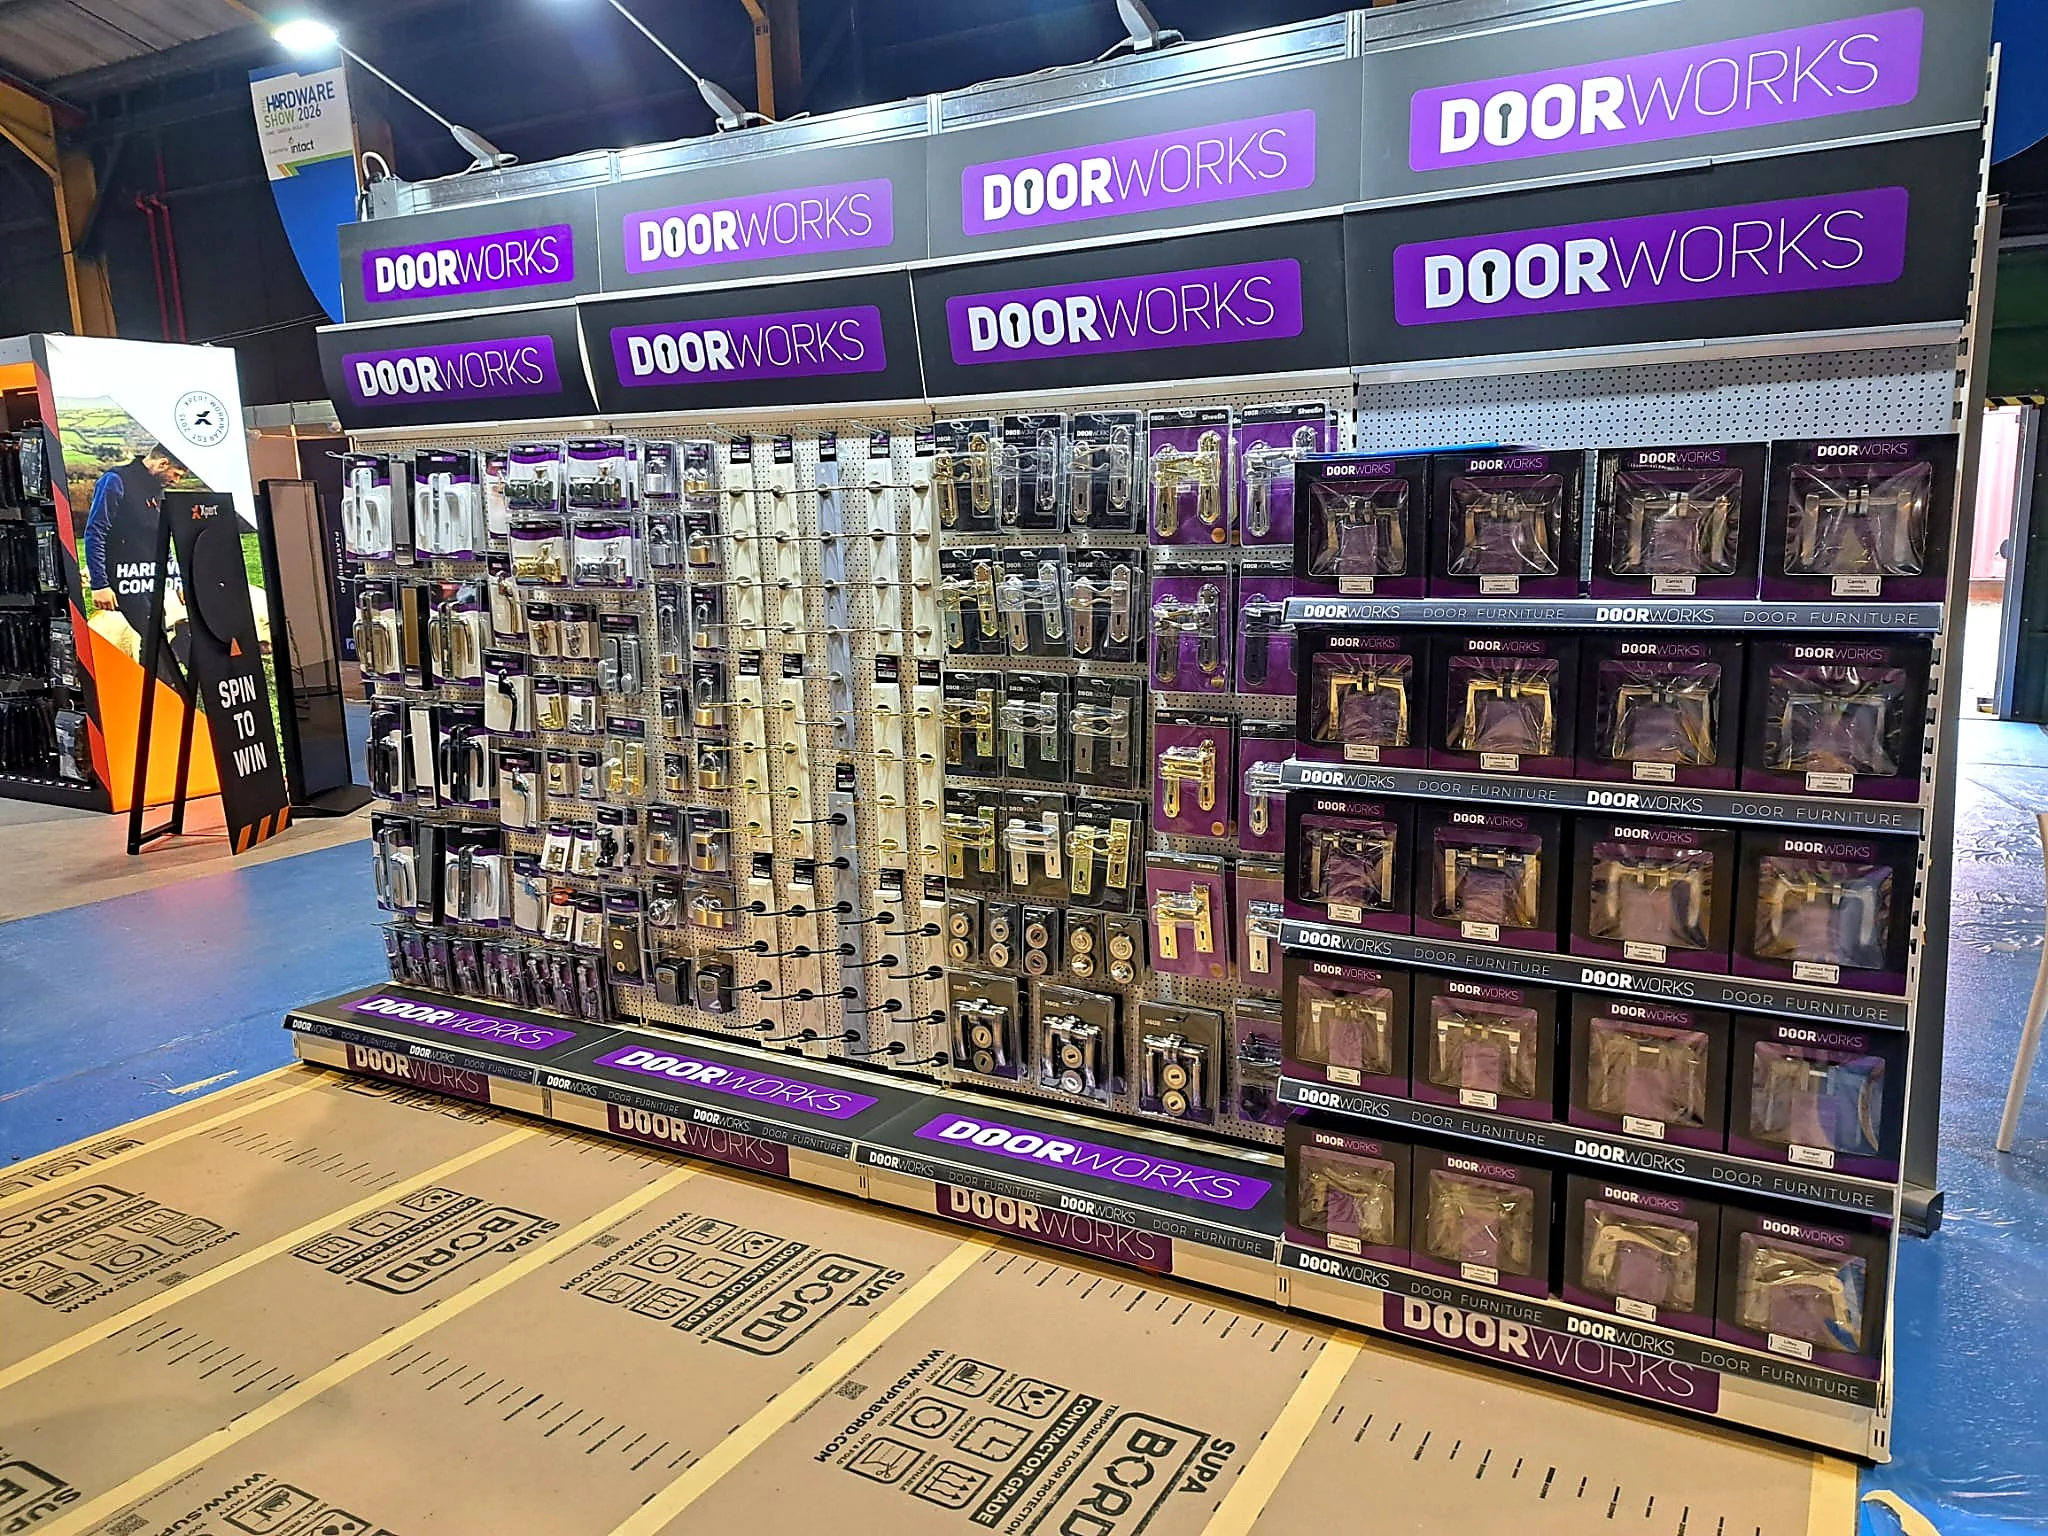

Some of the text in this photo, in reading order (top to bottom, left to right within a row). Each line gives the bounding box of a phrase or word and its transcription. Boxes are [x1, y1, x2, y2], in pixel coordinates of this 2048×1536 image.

[264, 104, 321, 128] SHOW 2026
[266, 81, 335, 113] HARDWARE
[1440, 34, 1879, 153] DOORWORKS
[983, 128, 1287, 221] DOORWORKS
[639, 193, 872, 262] DOORWORKS
[375, 236, 559, 293] DOORWORKS
[1425, 210, 1864, 309] DOORWORKS
[968, 276, 1275, 352] DOORWORKS
[628, 319, 864, 376] DOORWORKS
[355, 347, 543, 397] DOORWORKS
[1326, 463, 1391, 476] DOORWORKS
[1470, 457, 1543, 471] DOORWORKS
[1639, 450, 1720, 464] DOORWORKS
[1817, 443, 1908, 457] DOORWORKS
[1304, 605, 1919, 625] DOORWORKS DOOR FURNITURE DOORWORKS DOOR FURNITURE
[1330, 637, 1395, 649] DOORWORKS
[1468, 639, 1540, 652] DOORWORKS
[1621, 643, 1700, 657] DOORWORKS
[1795, 646, 1882, 660] DOORWORKS
[218, 675, 256, 708] SPIN
[233, 710, 255, 740] TO
[233, 742, 267, 777] WIN
[1300, 769, 1903, 826] DOORWORKS DOOR FURNITURE DOORWORKS DOOR FURNITURE
[1317, 800, 1380, 815] DOORWORKS
[1453, 813, 1523, 828] DOORWORKS
[1614, 826, 1692, 843] DOORWORKS
[1784, 840, 1870, 857] DOORWORKS
[1299, 930, 1889, 1021] DOORWORKS DOOR FURNITURE DOORWORKS DOOR FURNITURE
[1313, 963, 1376, 979] DOORWORKS
[1449, 982, 1519, 1001] DOORWORKS
[358, 998, 553, 1045] DOORWORKS
[1611, 1004, 1688, 1023] DOORWORKS
[1778, 1027, 1863, 1047] DOORWORKS
[293, 1020, 334, 1036] DOORWORKS
[409, 1045, 455, 1063] DOORWORKS
[355, 1046, 479, 1094] DOORWORKS
[614, 1046, 851, 1112] DOORWORKS
[547, 1075, 842, 1153] DOORWORKS DOOR FURNITURE DOORWORKS DOOR FURNITURE
[619, 1106, 776, 1165] DOORWORKS
[938, 1119, 1241, 1200] DOORWORKS
[1299, 1088, 1874, 1207] DOORWORKS DOOR FURNITURE DOORWORKS DOOR FURNITURE
[1315, 1134, 1378, 1153] DOORWORKS
[1447, 1157, 1516, 1179] DOORWORKS
[389, 1198, 476, 1245] CONTRACTOR
[869, 1151, 1262, 1254] DOORWORKS DOOR FURNITURE DOORWORKS DOOR FURNITURE
[1604, 1187, 1680, 1211] DOORWORKS
[500, 1220, 561, 1254] SUPA
[950, 1186, 1156, 1260] DOORWORKS
[1762, 1219, 1845, 1246] DOORWORKS
[60, 1231, 241, 1314] WWW.SUPABORD.COM
[560, 1212, 692, 1290] WWW.SUPABORD.COM
[723, 1243, 801, 1298] CONTRACTOR
[696, 1249, 822, 1336] TEMPORARY FLOOR PROTECTION
[848, 1270, 905, 1307] SUPA
[678, 1298, 725, 1328] GRADE
[1299, 1253, 1860, 1399] DOORWORKS DOOR FURNITURE DOORWORKS DOOR FURNITURE
[1404, 1297, 1694, 1397] DOORWORKS
[814, 1349, 944, 1462] WWW.SUPABORD.COM
[976, 1399, 1093, 1523] CONTRACTOR GRADE
[1004, 1404, 1120, 1536] TEMPORARY FLOOR PROTECTION
[1178, 1438, 1236, 1494] SUPA
[4, 1487, 82, 1536] SUP
